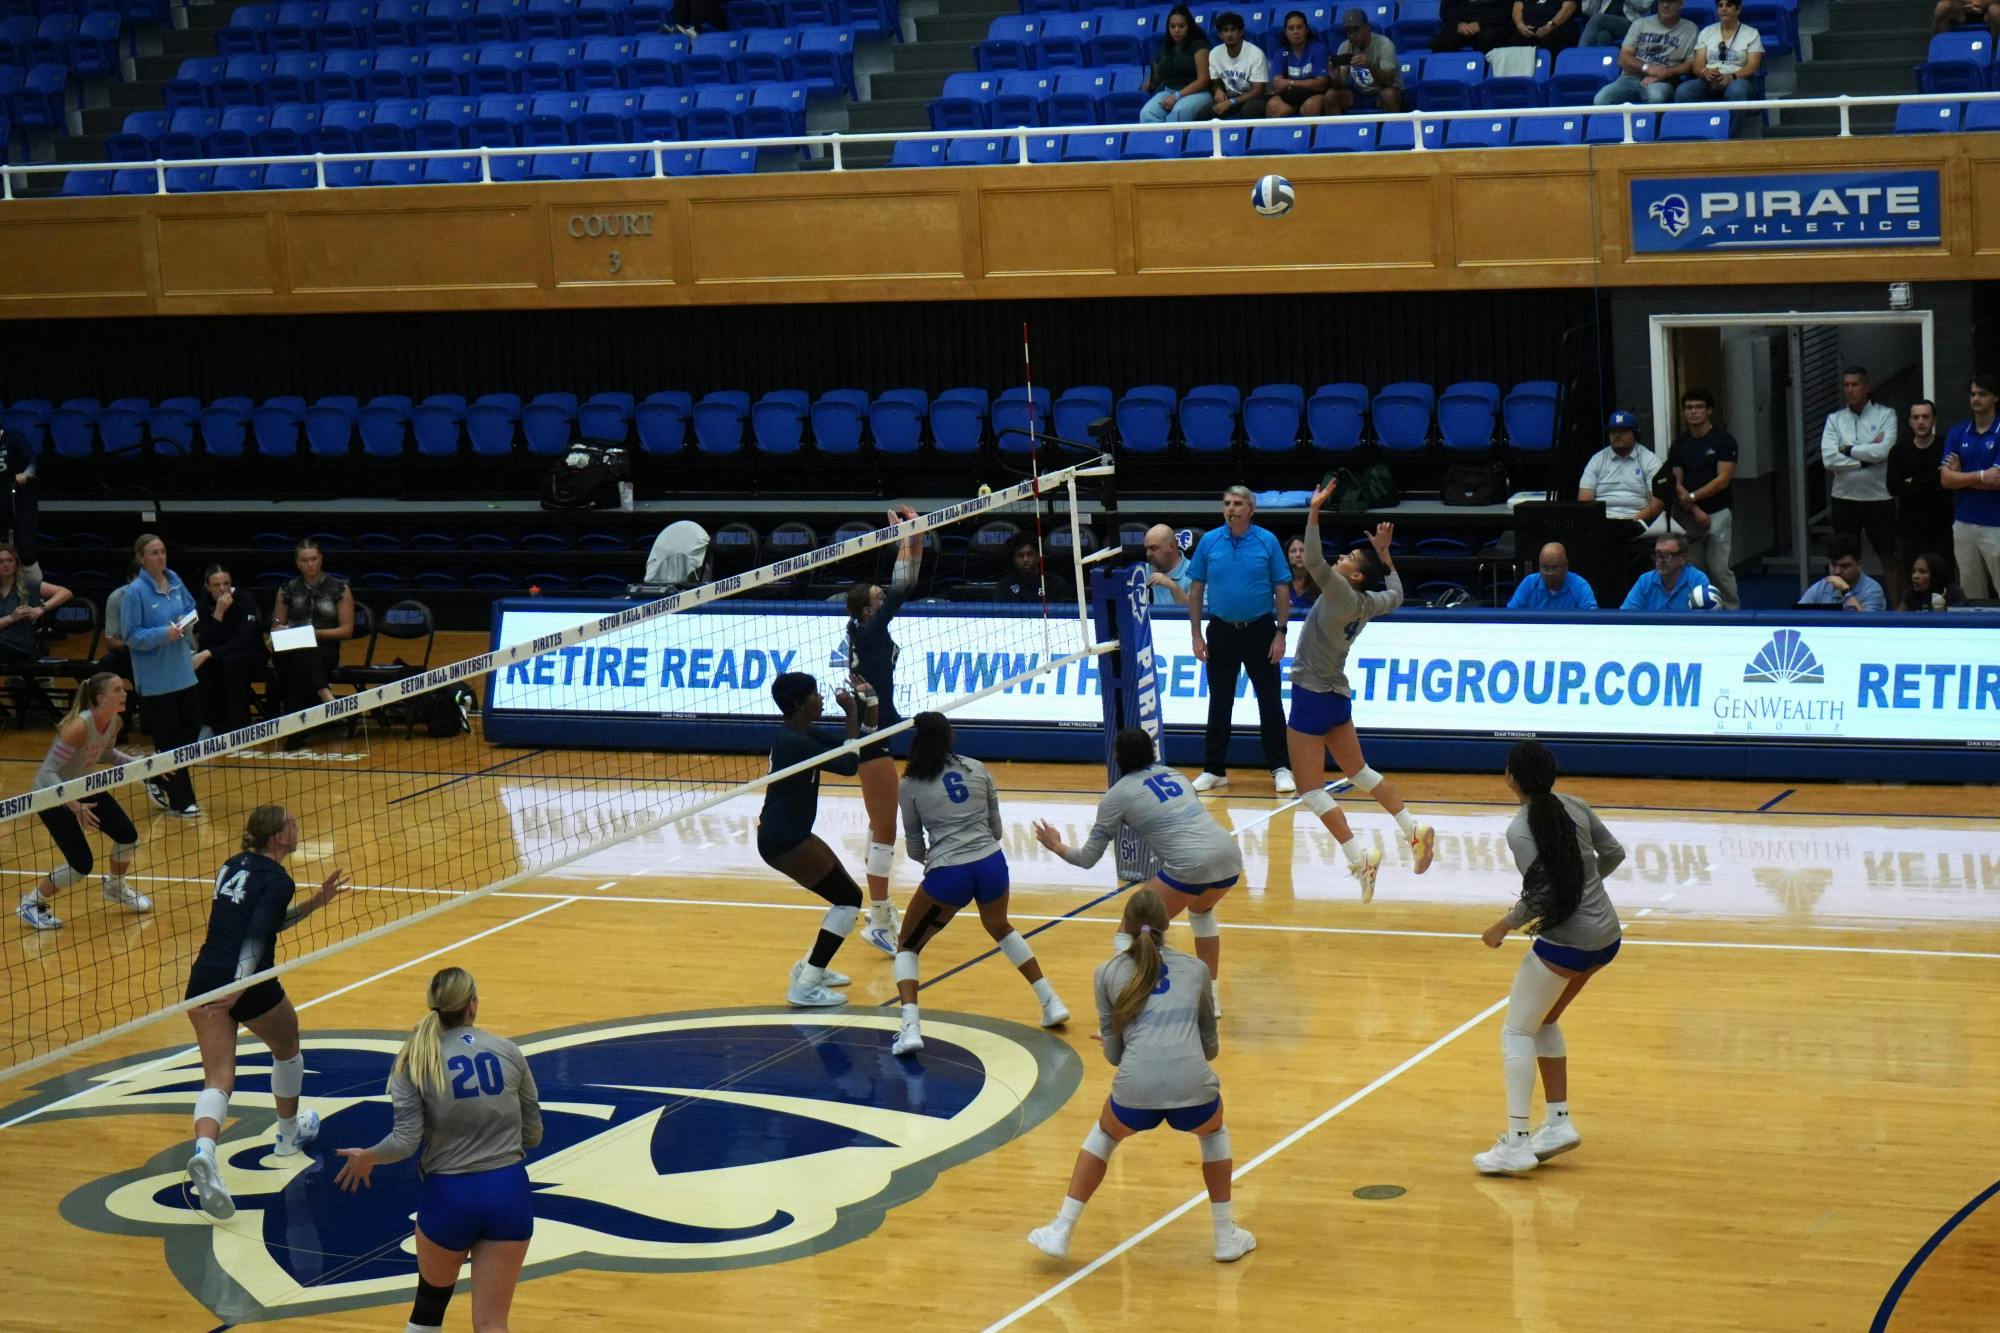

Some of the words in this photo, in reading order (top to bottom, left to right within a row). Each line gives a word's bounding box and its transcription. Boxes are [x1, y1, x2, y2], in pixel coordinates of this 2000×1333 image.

[1701, 186, 1920, 218] PIRATE
[567, 212, 655, 238] COURT
[1701, 220, 1920, 235] ATHLETICS
[608, 250, 621, 273] 3
[810, 542, 845, 564] UNIVERSITY
[714, 576, 741, 595] PIRATES
[599, 614, 620, 632] SETON
[622, 607, 640, 625] HALL
[642, 595, 681, 618] UNIVERSITY
[533, 632, 562, 653] PIRATES
[401, 676, 425, 695] SETON
[427, 668, 448, 687] HALL
[450, 653, 494, 680] UNIVERSITY
[506, 646, 649, 688] RETIRE
[660, 648, 797, 690] READY
[325, 696, 359, 719] PIRATES
[173, 747, 200, 765] SETON
[203, 737, 227, 756] HALL
[230, 719, 280, 747] UNIVERSITY
[85, 767, 124, 792] PIRATES
[942, 771, 970, 804] 6
[1142, 773, 1184, 804] 15
[213, 864, 250, 905] 14
[447, 1051, 505, 1100] 20
